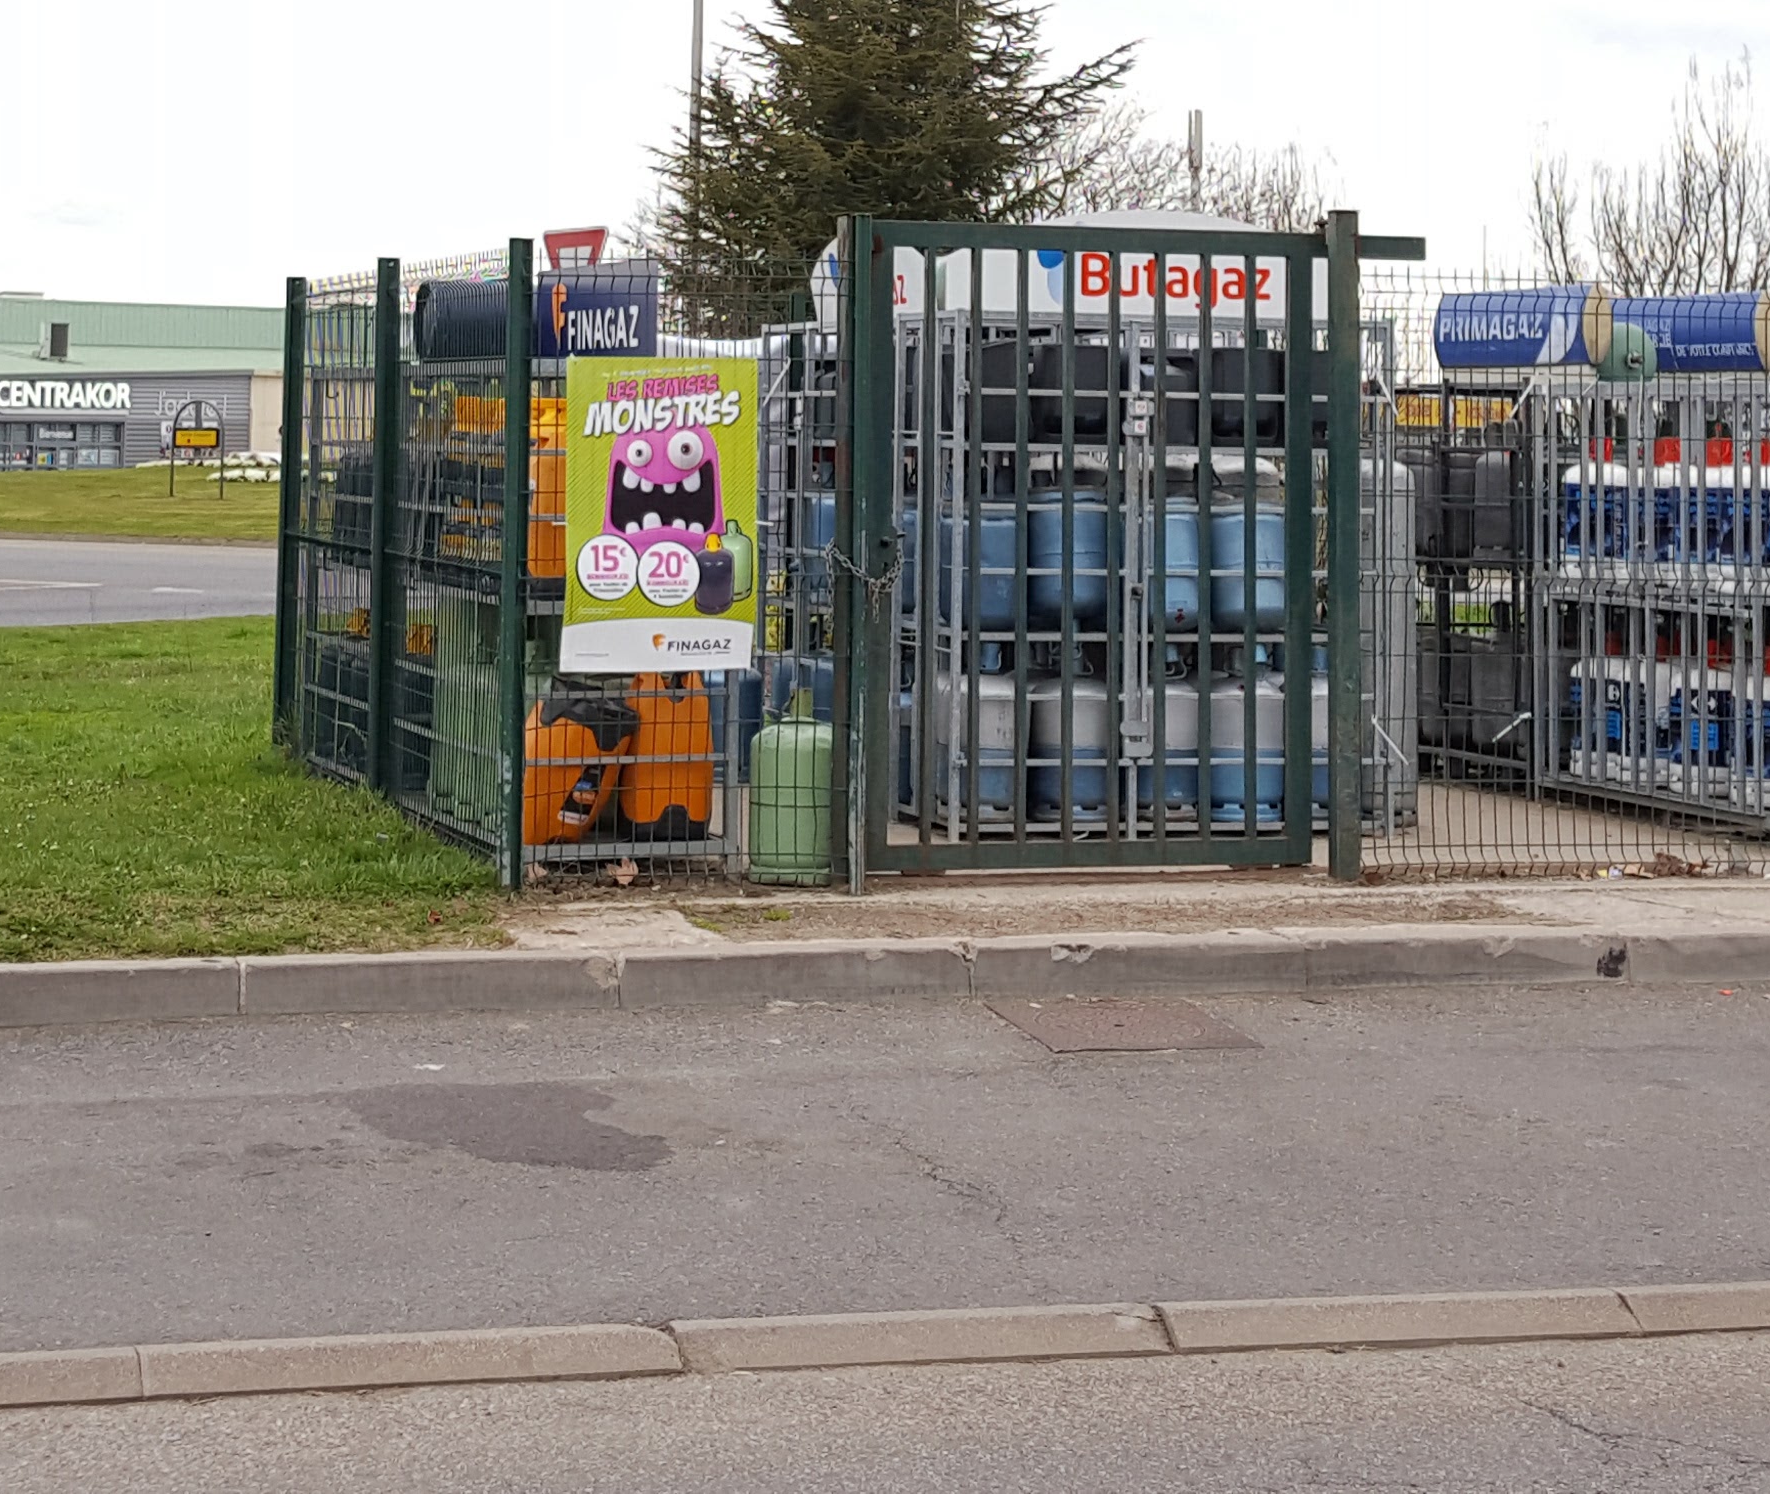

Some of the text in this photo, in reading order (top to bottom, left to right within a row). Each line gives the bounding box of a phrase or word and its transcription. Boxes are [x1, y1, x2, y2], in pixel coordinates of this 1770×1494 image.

[567, 304, 640, 352] FINAGAZ
[1439, 312, 1544, 343] PRIMAGAZ
[607, 374, 720, 402] LES REMISES
[583, 390, 742, 438] MONSTRES
[667, 638, 732, 653] FINAGAZ
